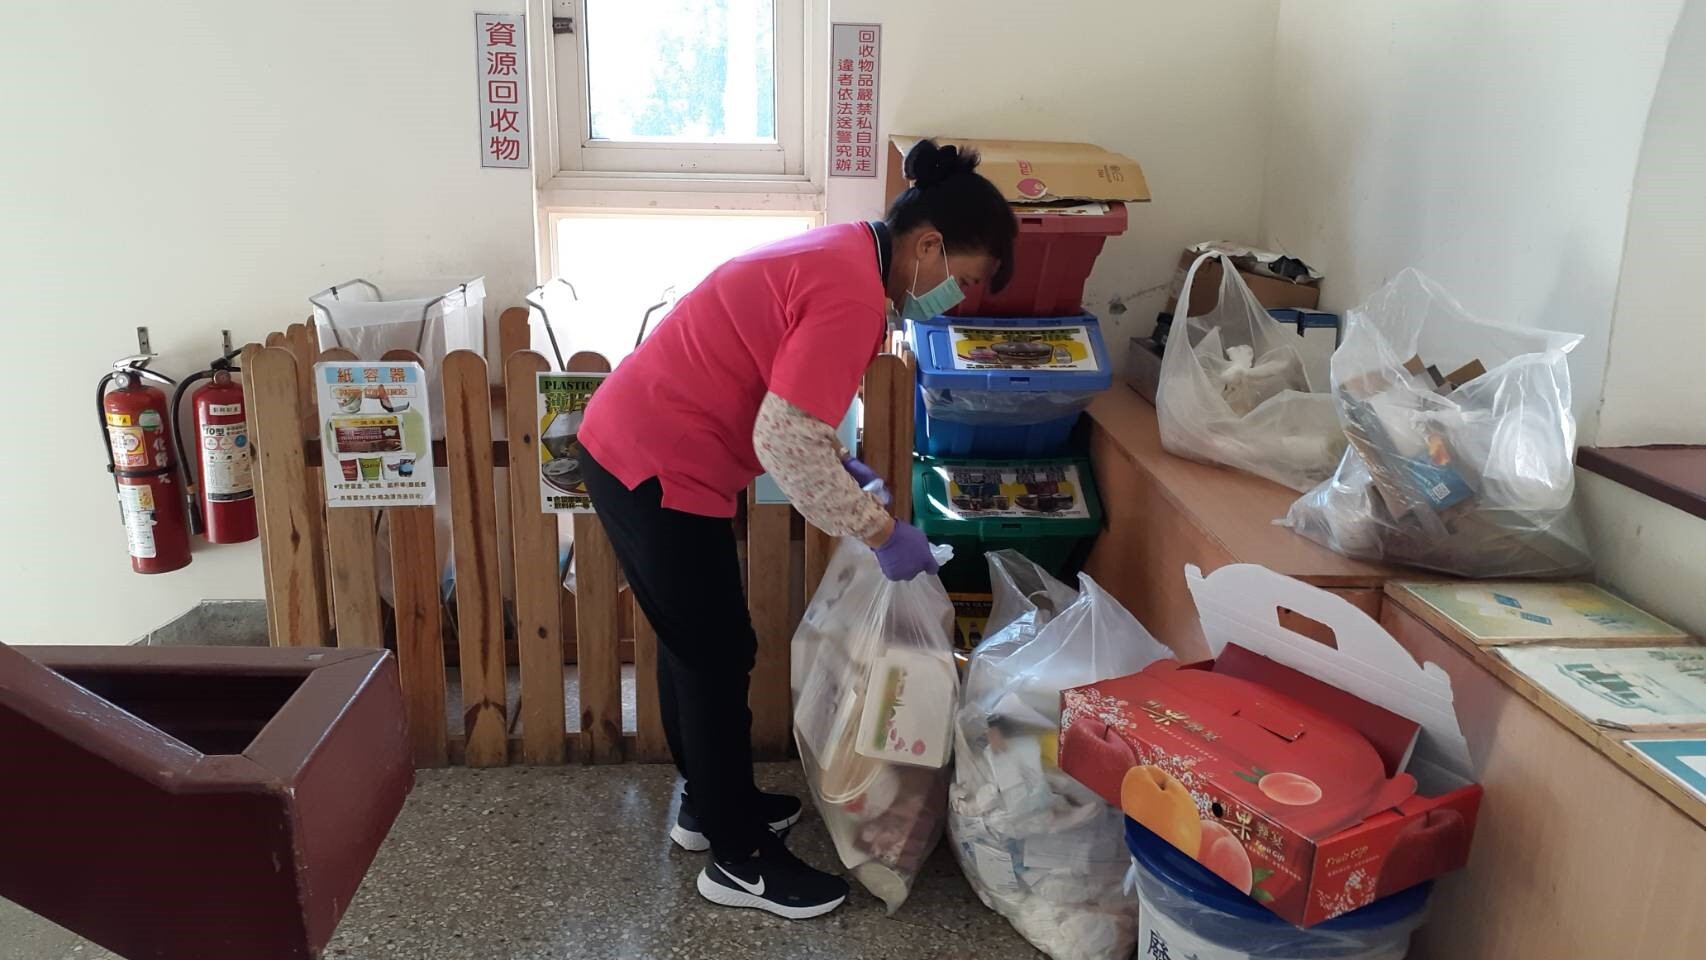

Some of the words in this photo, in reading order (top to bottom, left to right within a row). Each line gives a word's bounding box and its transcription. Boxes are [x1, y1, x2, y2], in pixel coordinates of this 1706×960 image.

[485, 21, 520, 161] 資源回收物
[836, 58, 854, 172] 違者依法送警究辦
[856, 30, 875, 172] 回收物品嚴禁私自取走
[337, 367, 407, 383] 紙容器
[544, 380, 593, 390] PLASTIC
